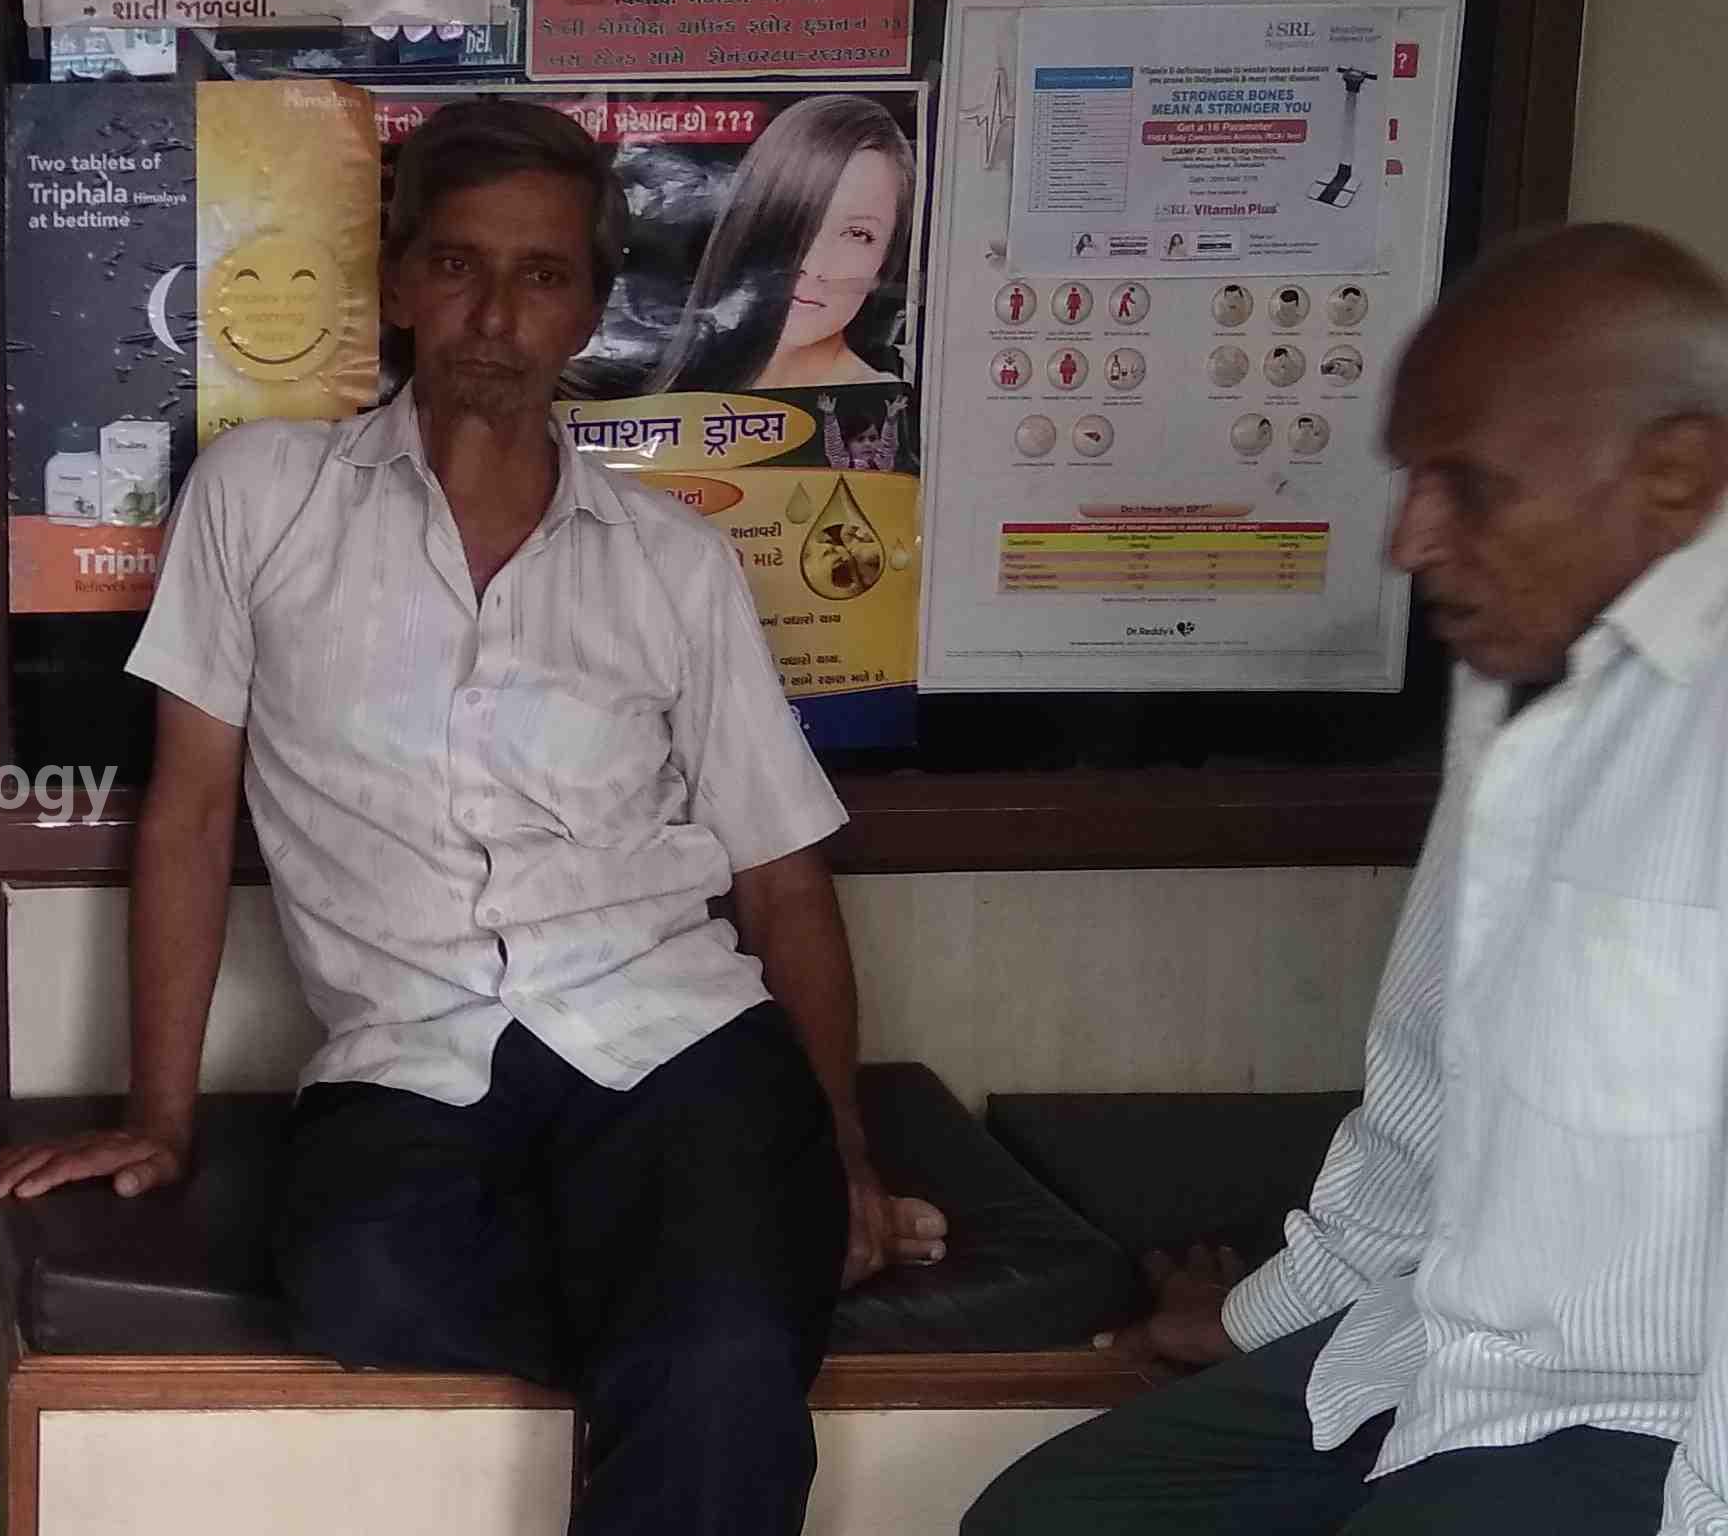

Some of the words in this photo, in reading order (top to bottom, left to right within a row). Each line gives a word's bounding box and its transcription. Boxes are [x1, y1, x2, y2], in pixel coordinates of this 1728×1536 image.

[1276, 22, 1315, 37] SRL
[1172, 90, 1247, 103] STRONGER
[1249, 89, 1294, 101] BONES
[1152, 103, 1193, 115] MEAN
[1194, 103, 1202, 115] A
[1207, 102, 1279, 115] STRONGER
[1284, 102, 1311, 113] YOU
[714, 110, 754, 132] ???
[27, 154, 66, 172] Two
[70, 154, 136, 172] tablets
[141, 153, 162, 170] of
[27, 182, 128, 208] Triphala
[133, 191, 188, 205] Himalaya
[28, 213, 48, 228] at
[53, 210, 130, 228] bedtime
[1194, 204, 1246, 215] Vitamin
[703, 401, 786, 456] ड्रोप्स
[73, 545, 157, 580] Triph
[752, 546, 784, 566] માટે
